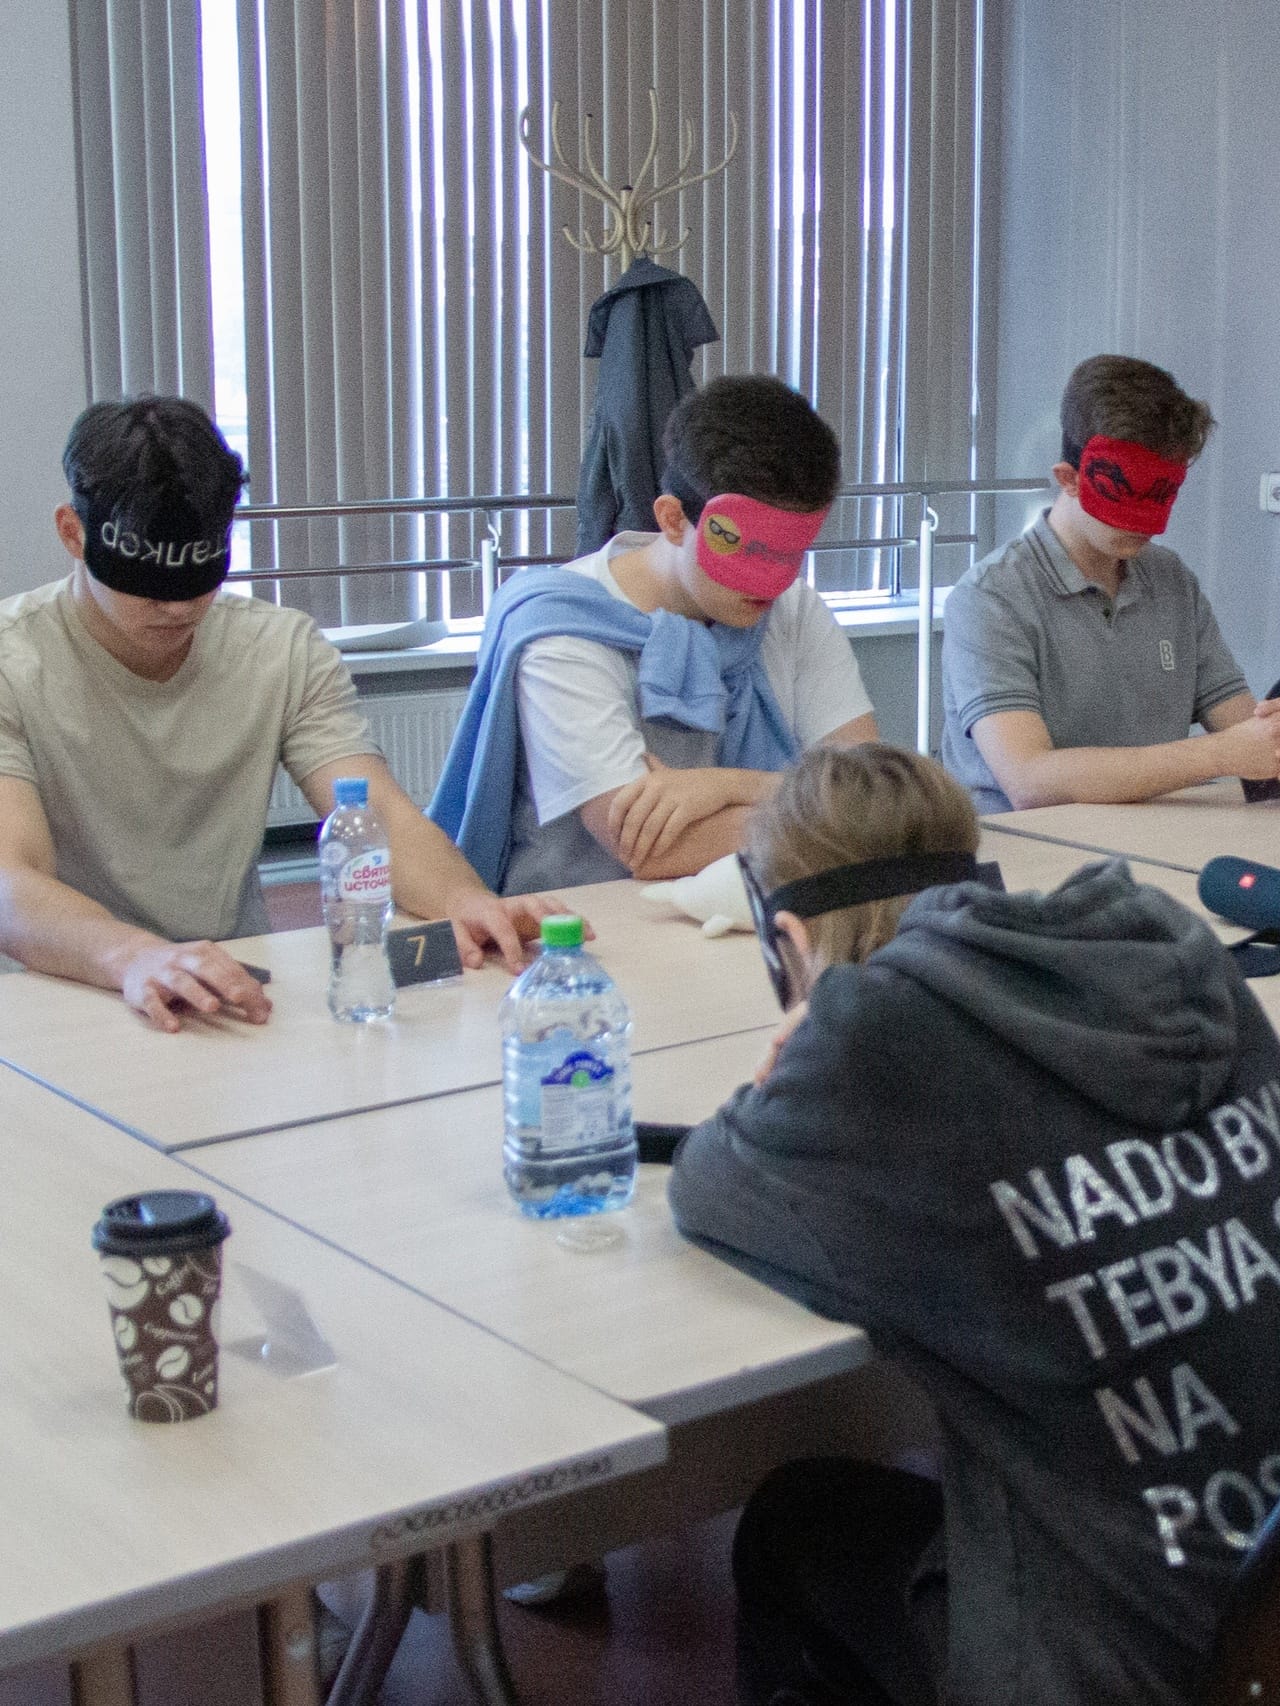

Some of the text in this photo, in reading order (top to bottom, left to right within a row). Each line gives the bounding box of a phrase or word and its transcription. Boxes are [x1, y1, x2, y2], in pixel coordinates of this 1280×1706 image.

[406, 934, 427, 967] 7
[989, 1130, 1221, 1260] NADO
[1094, 1362, 1240, 1463] NA
